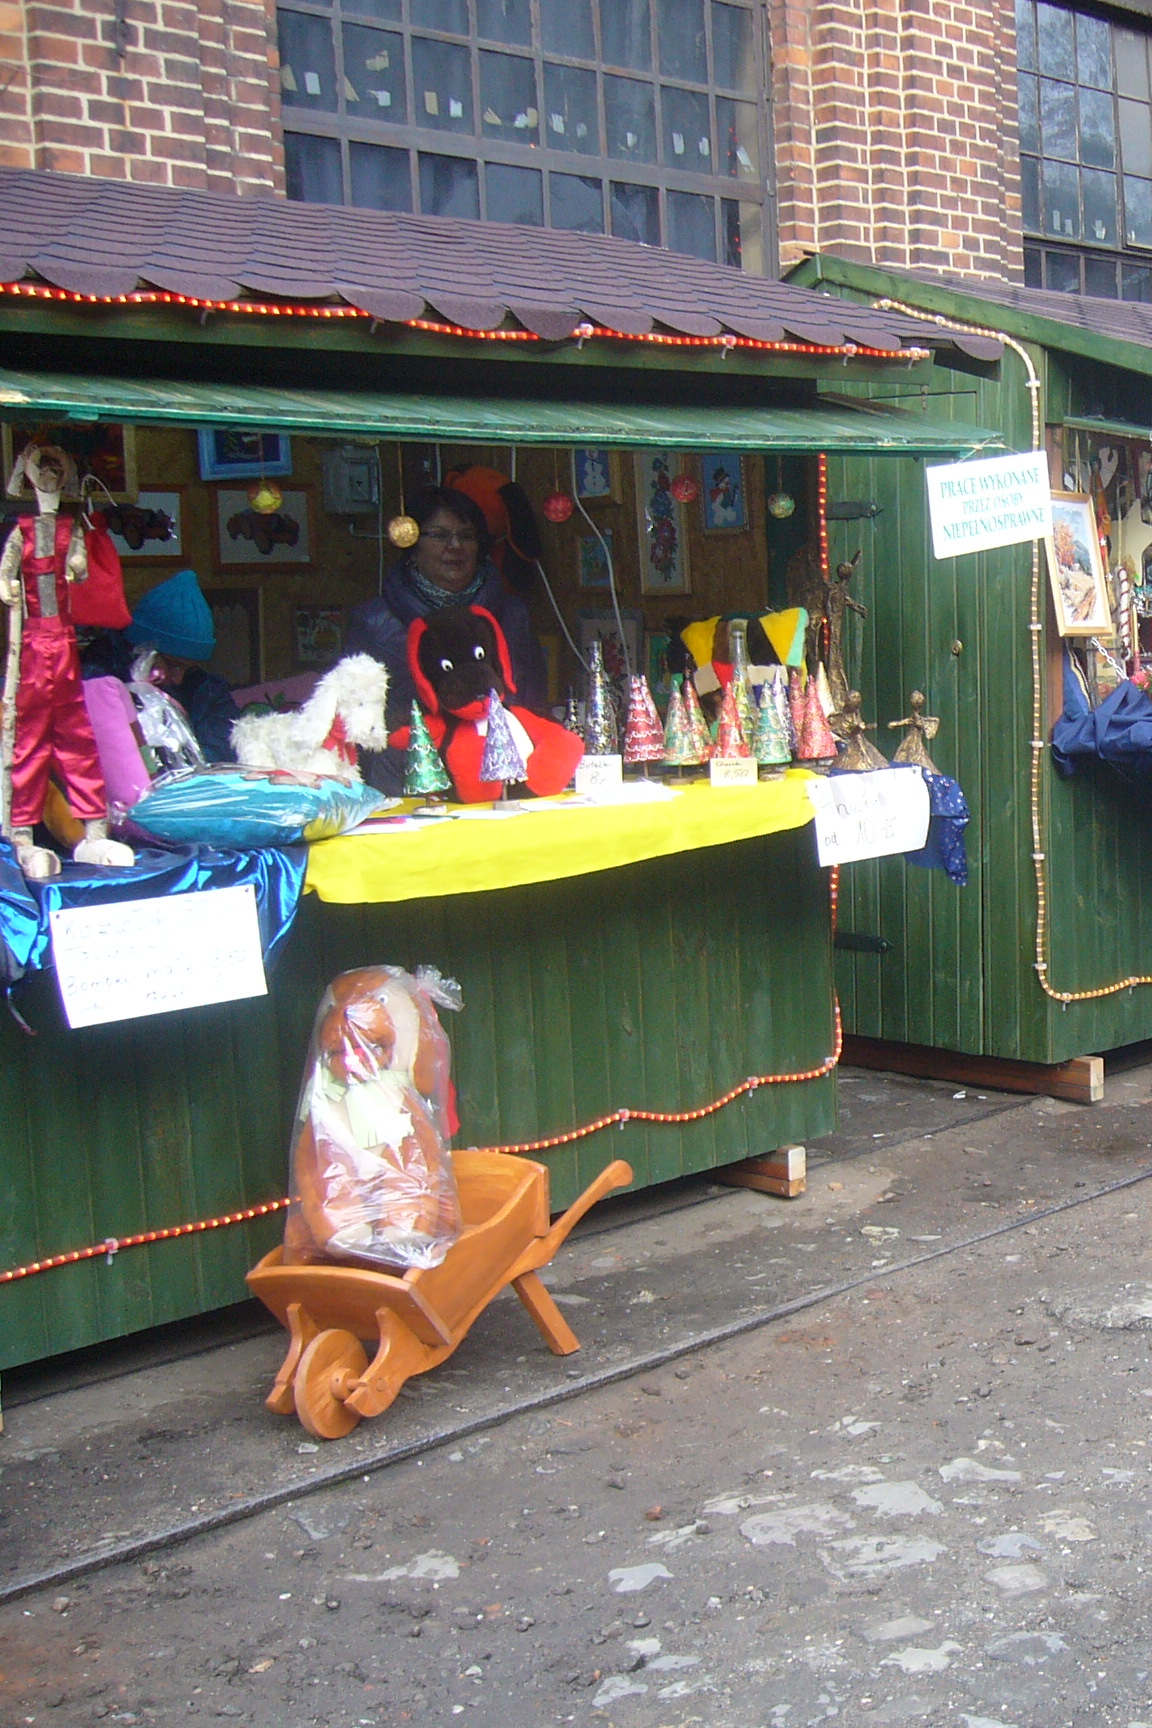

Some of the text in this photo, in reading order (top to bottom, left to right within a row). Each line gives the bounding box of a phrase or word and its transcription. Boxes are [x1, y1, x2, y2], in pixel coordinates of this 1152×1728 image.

[940, 467, 1041, 499] PRACE WYKONANE
[962, 492, 1024, 515] PRZEZ OSOBY
